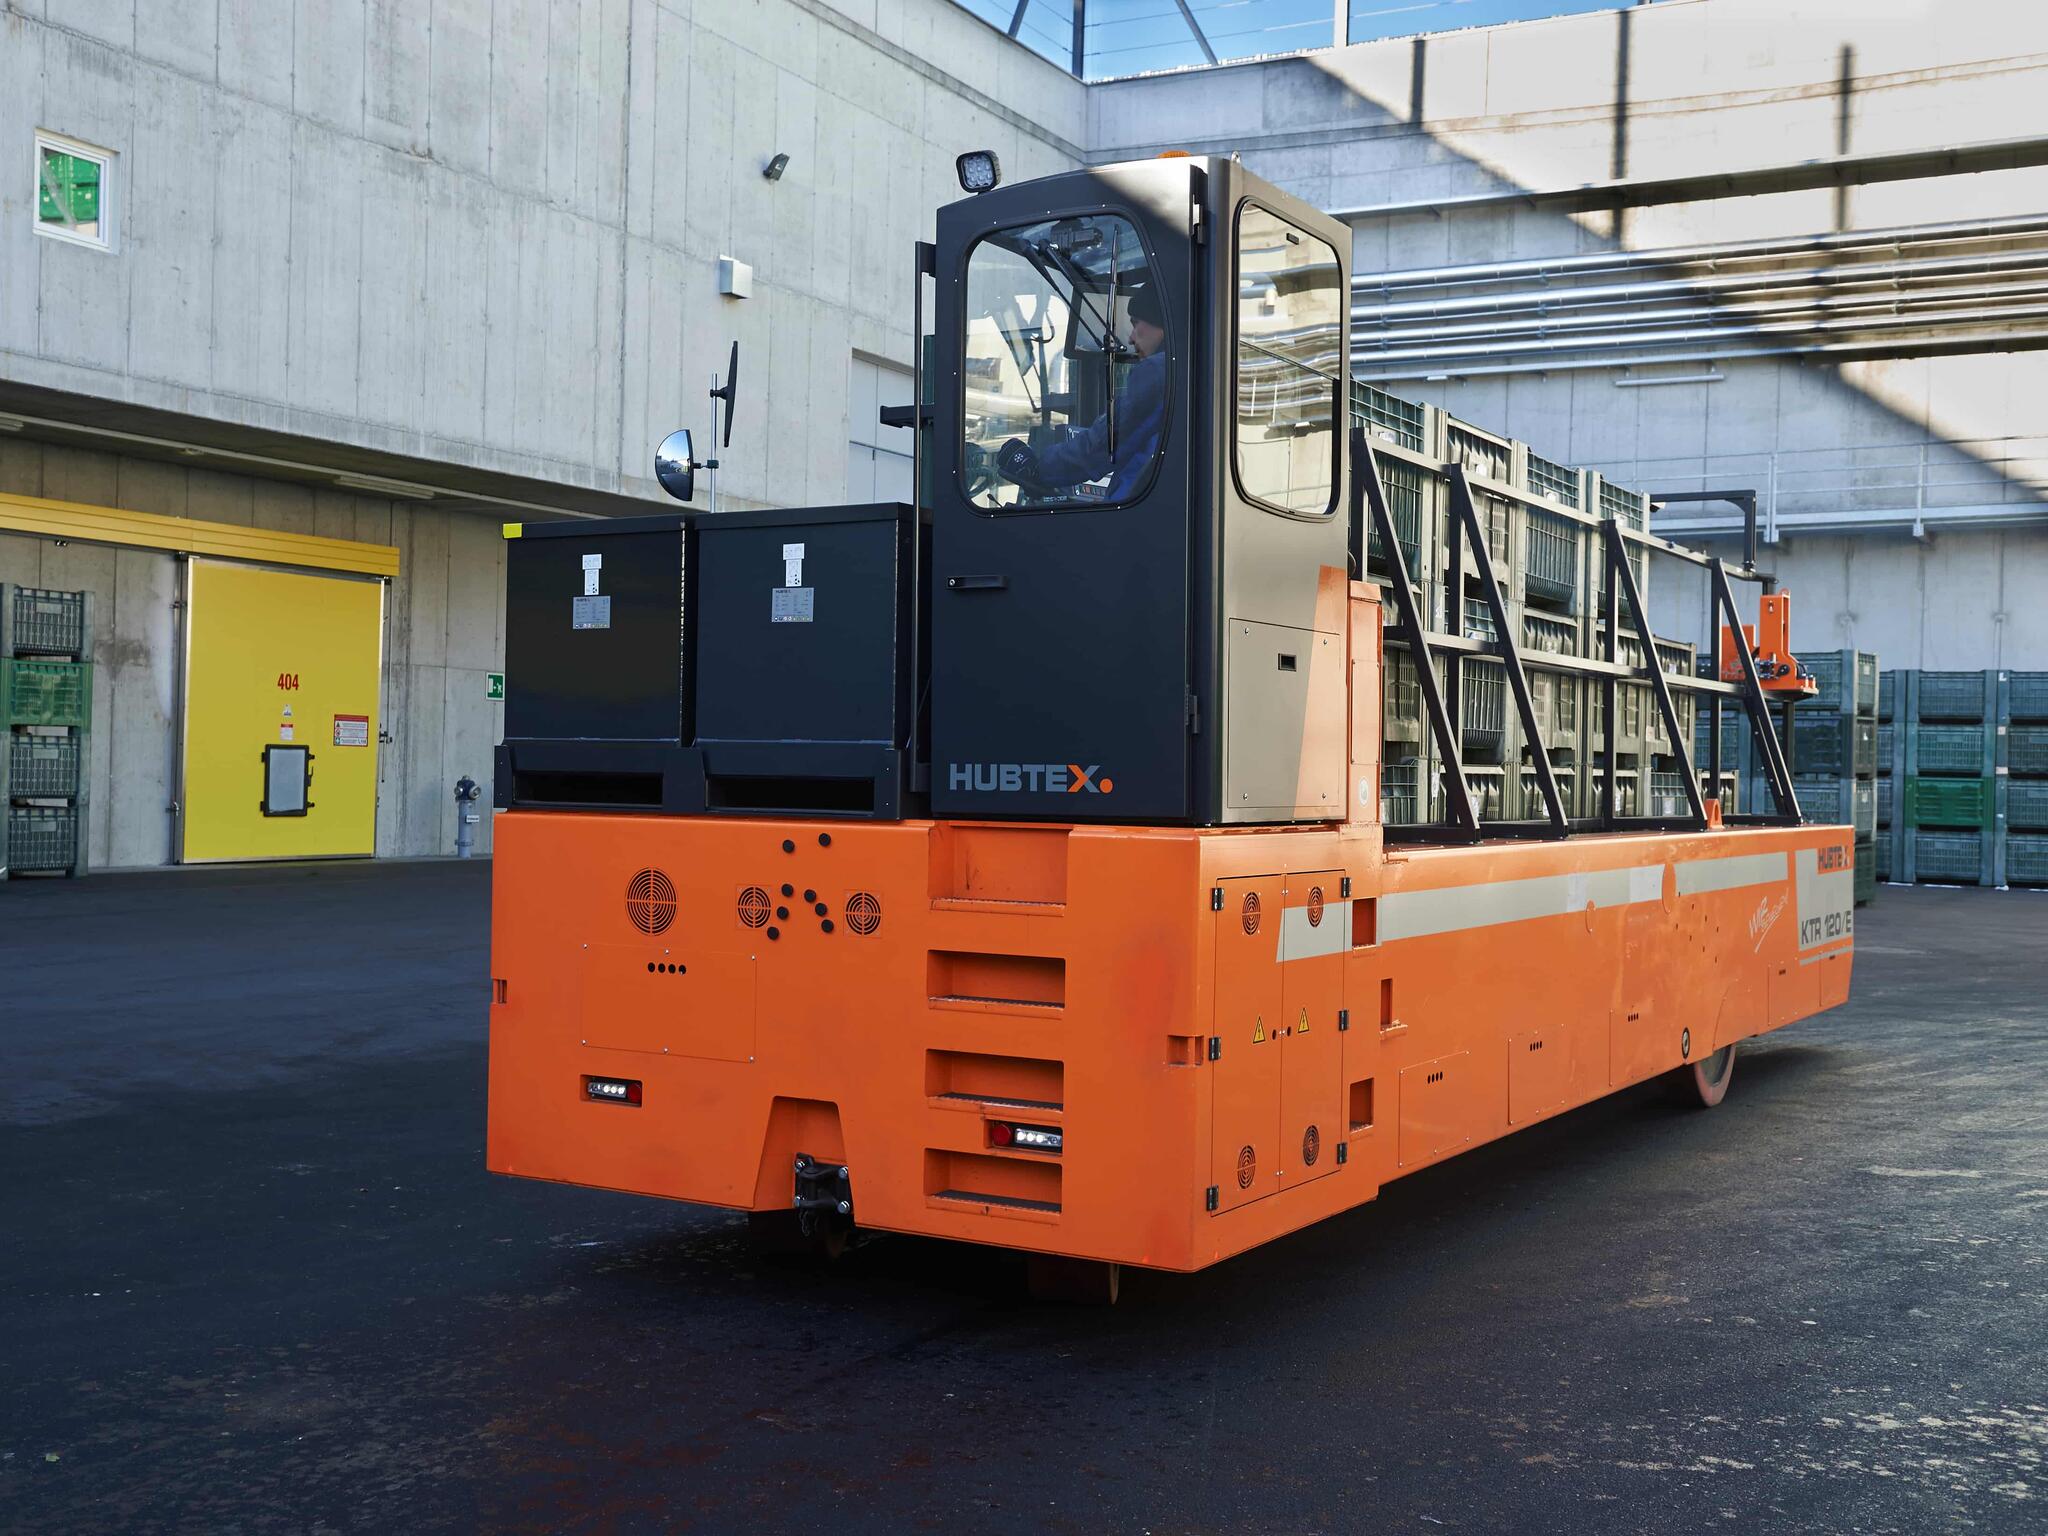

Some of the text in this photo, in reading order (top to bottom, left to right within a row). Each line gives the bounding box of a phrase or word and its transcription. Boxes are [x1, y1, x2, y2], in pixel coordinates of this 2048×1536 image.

[277, 673, 299, 690] 404
[1801, 910, 1852, 944] KTR 120/E
